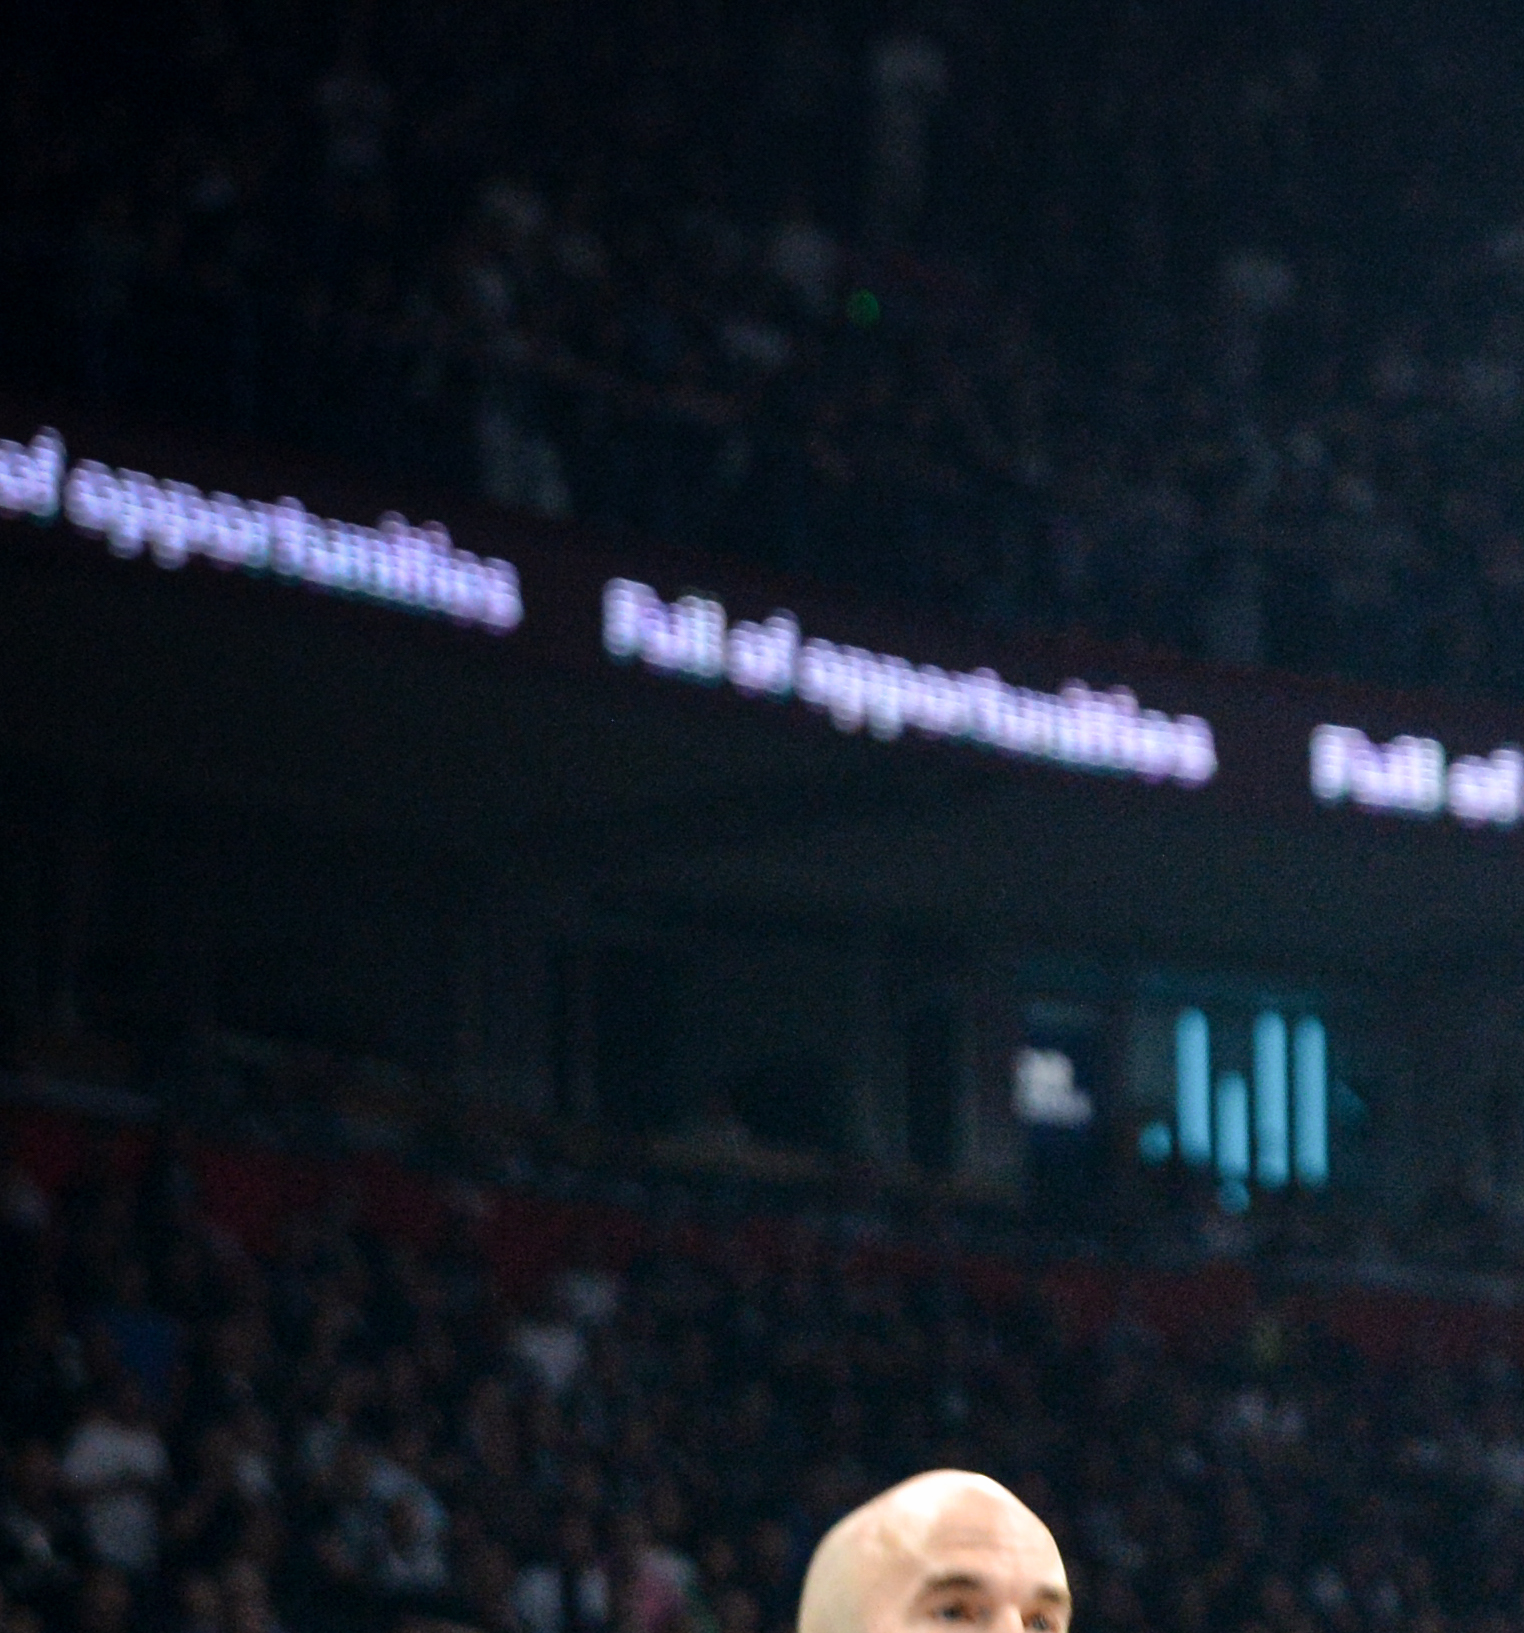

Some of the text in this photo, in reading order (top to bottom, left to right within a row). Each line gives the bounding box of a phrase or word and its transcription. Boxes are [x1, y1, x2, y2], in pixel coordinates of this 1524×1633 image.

[63, 458, 523, 634] opportunities
[602, 577, 1216, 789] Full of opportunities
[1308, 723, 1445, 815] Full
